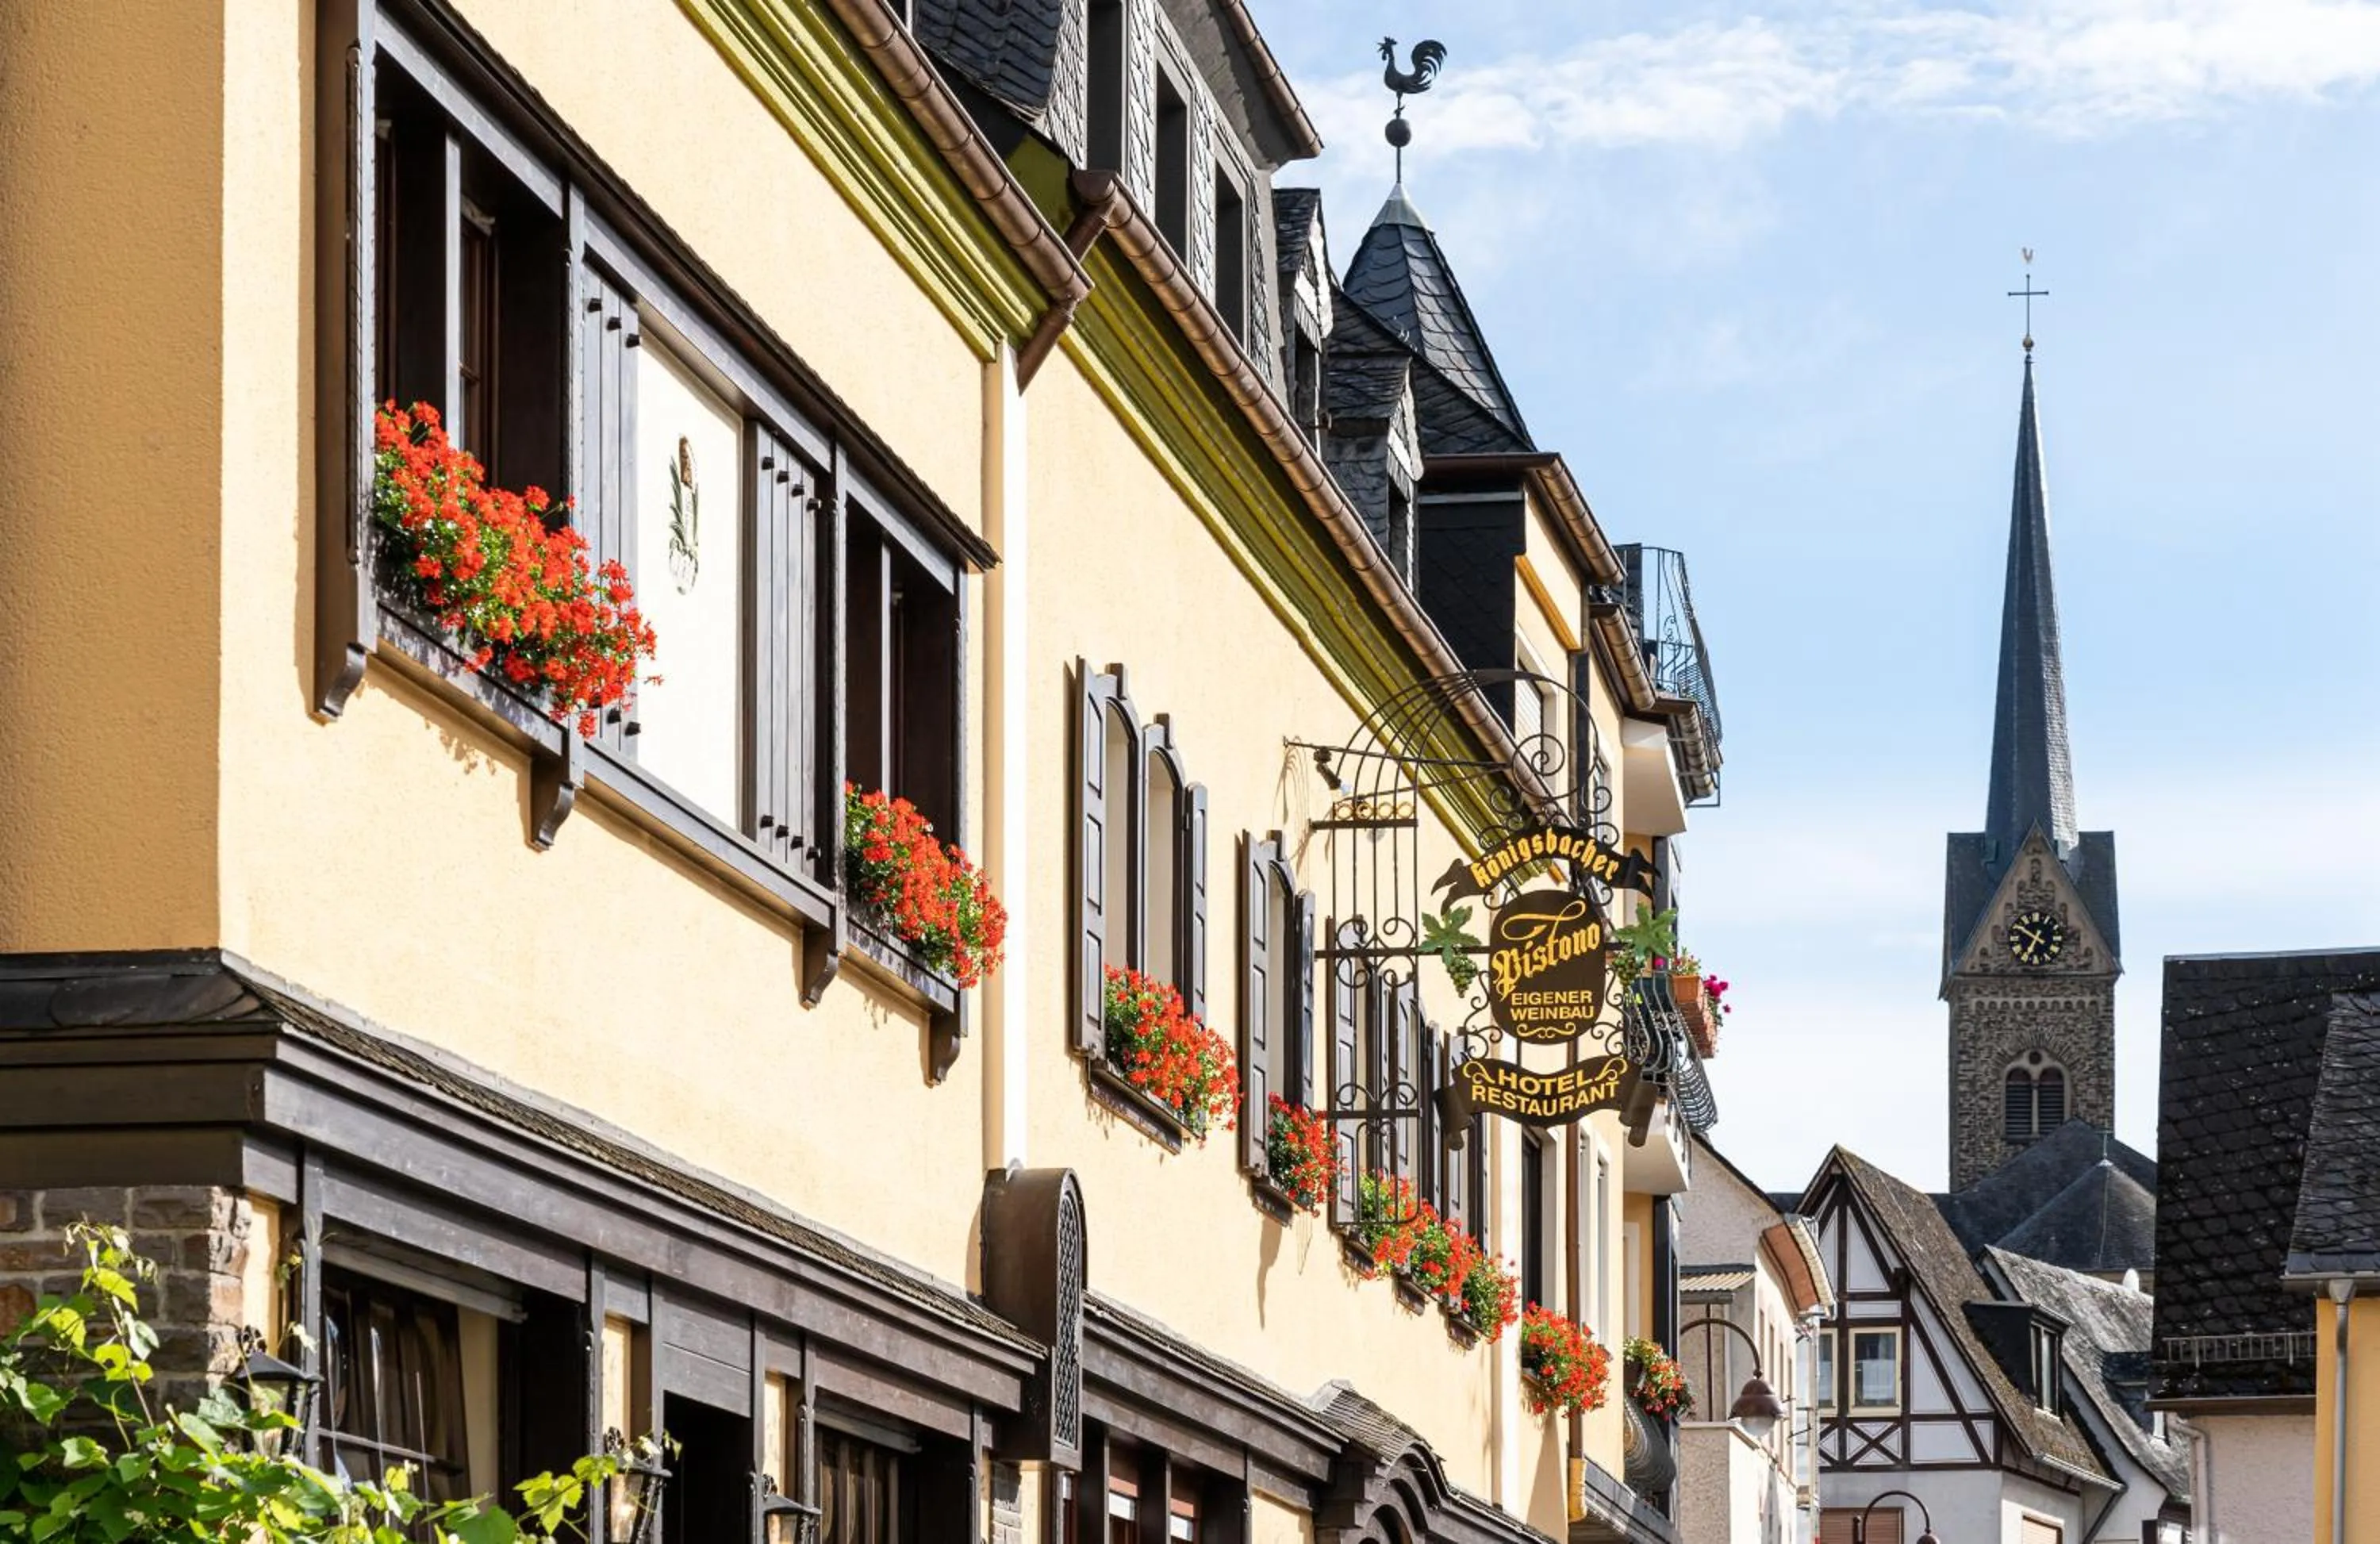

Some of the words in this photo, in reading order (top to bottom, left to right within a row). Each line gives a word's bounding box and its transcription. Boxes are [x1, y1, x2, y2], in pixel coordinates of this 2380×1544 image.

[1470, 828, 1621, 887] Königsbacher
[1491, 900, 1601, 1001] Pistono
[1511, 991, 1592, 1005] EIGENER
[1511, 1005, 1595, 1021] WEINBAU
[1497, 1067, 1593, 1096] HOTEL
[1472, 1081, 1620, 1116] RESTAURANT
